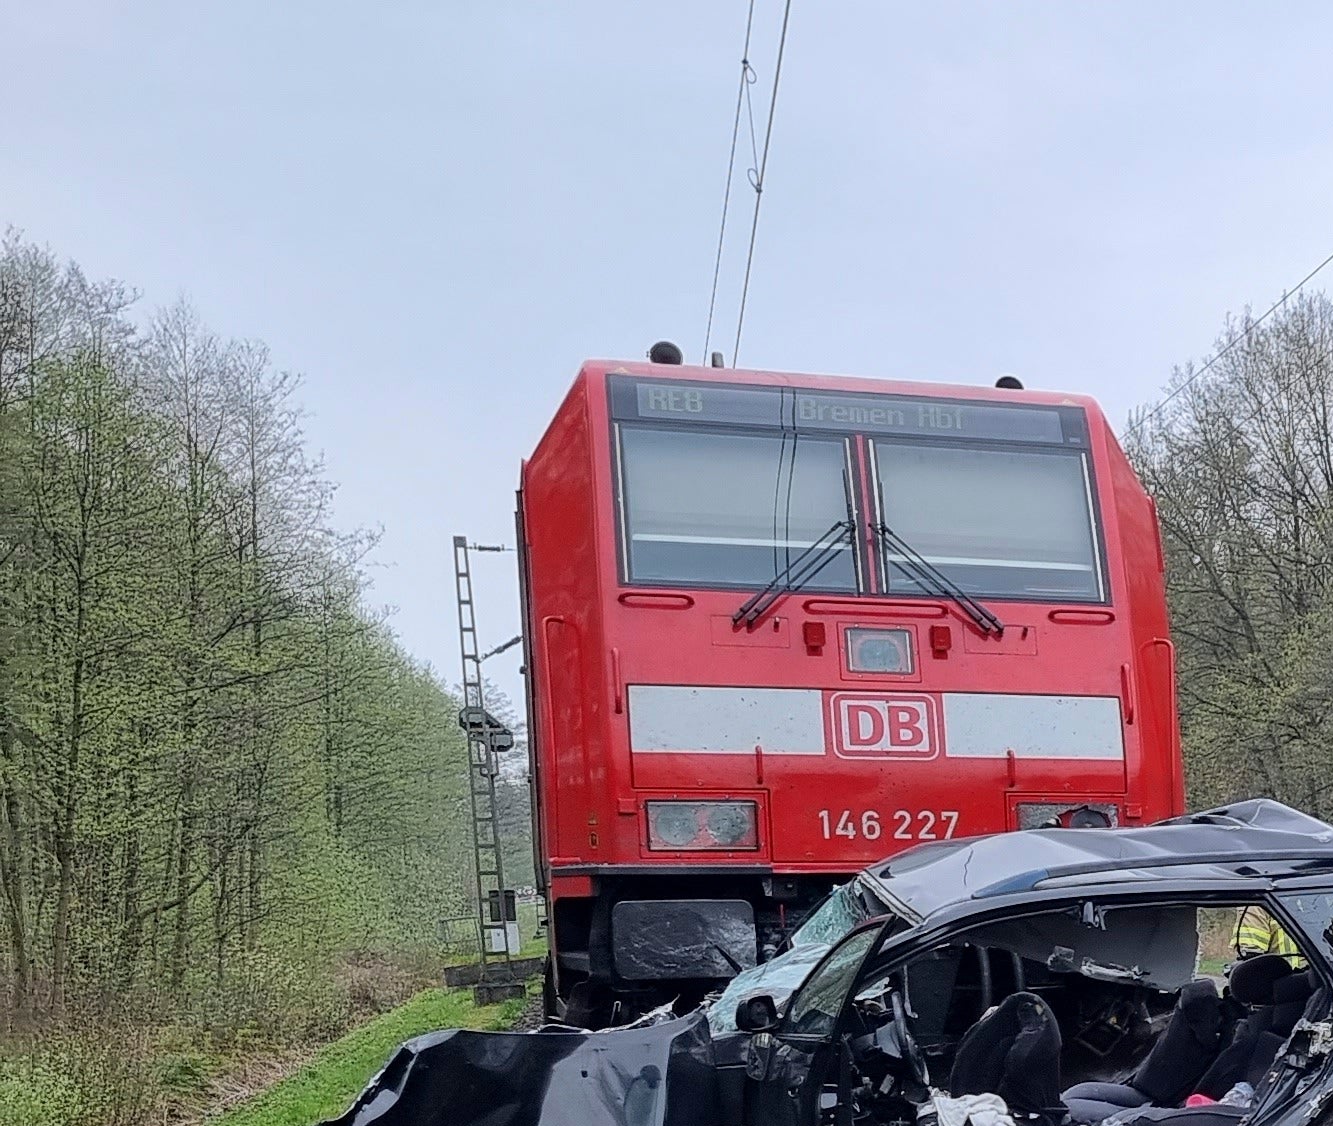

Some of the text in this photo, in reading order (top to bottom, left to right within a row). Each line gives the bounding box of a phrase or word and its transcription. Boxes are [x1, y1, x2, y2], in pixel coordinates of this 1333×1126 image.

[800, 399, 905, 426] Bremen
[917, 405, 966, 431] Hbf
[847, 704, 924, 746] DB
[818, 809, 959, 840] 146 227
